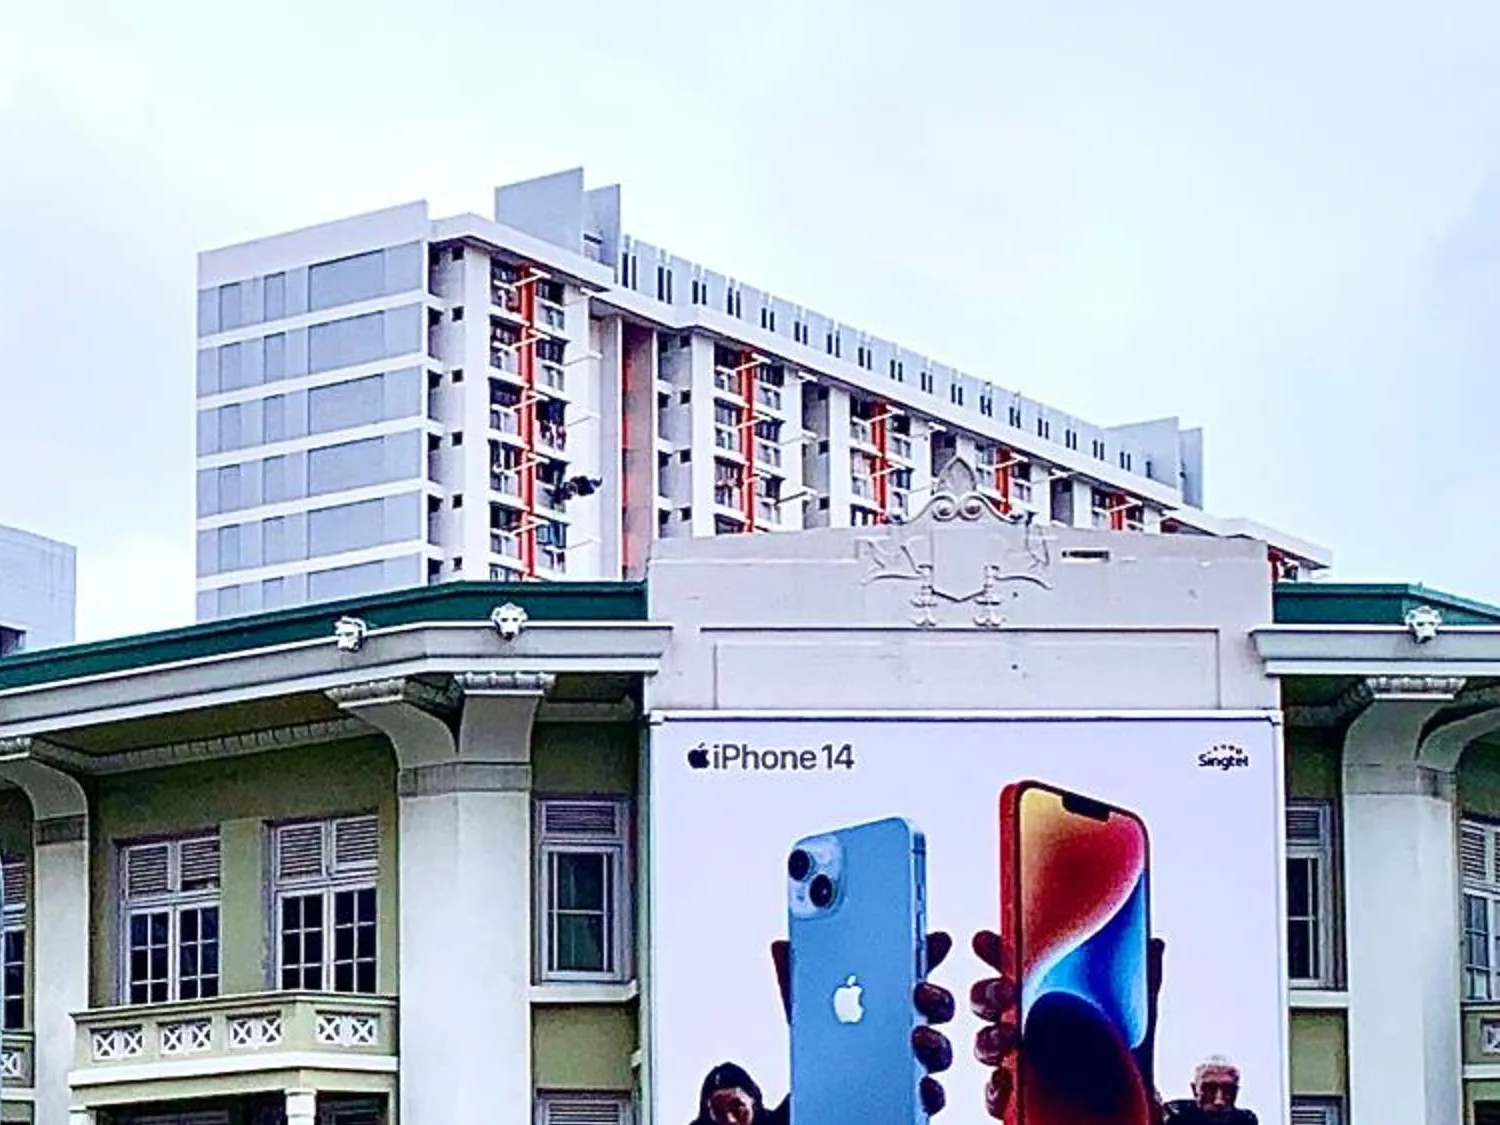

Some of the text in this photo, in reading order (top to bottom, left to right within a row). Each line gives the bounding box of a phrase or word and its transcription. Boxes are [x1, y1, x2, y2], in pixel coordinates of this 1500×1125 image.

[712, 743, 855, 770] iPhone 14
[1198, 753, 1249, 771] Singtel
